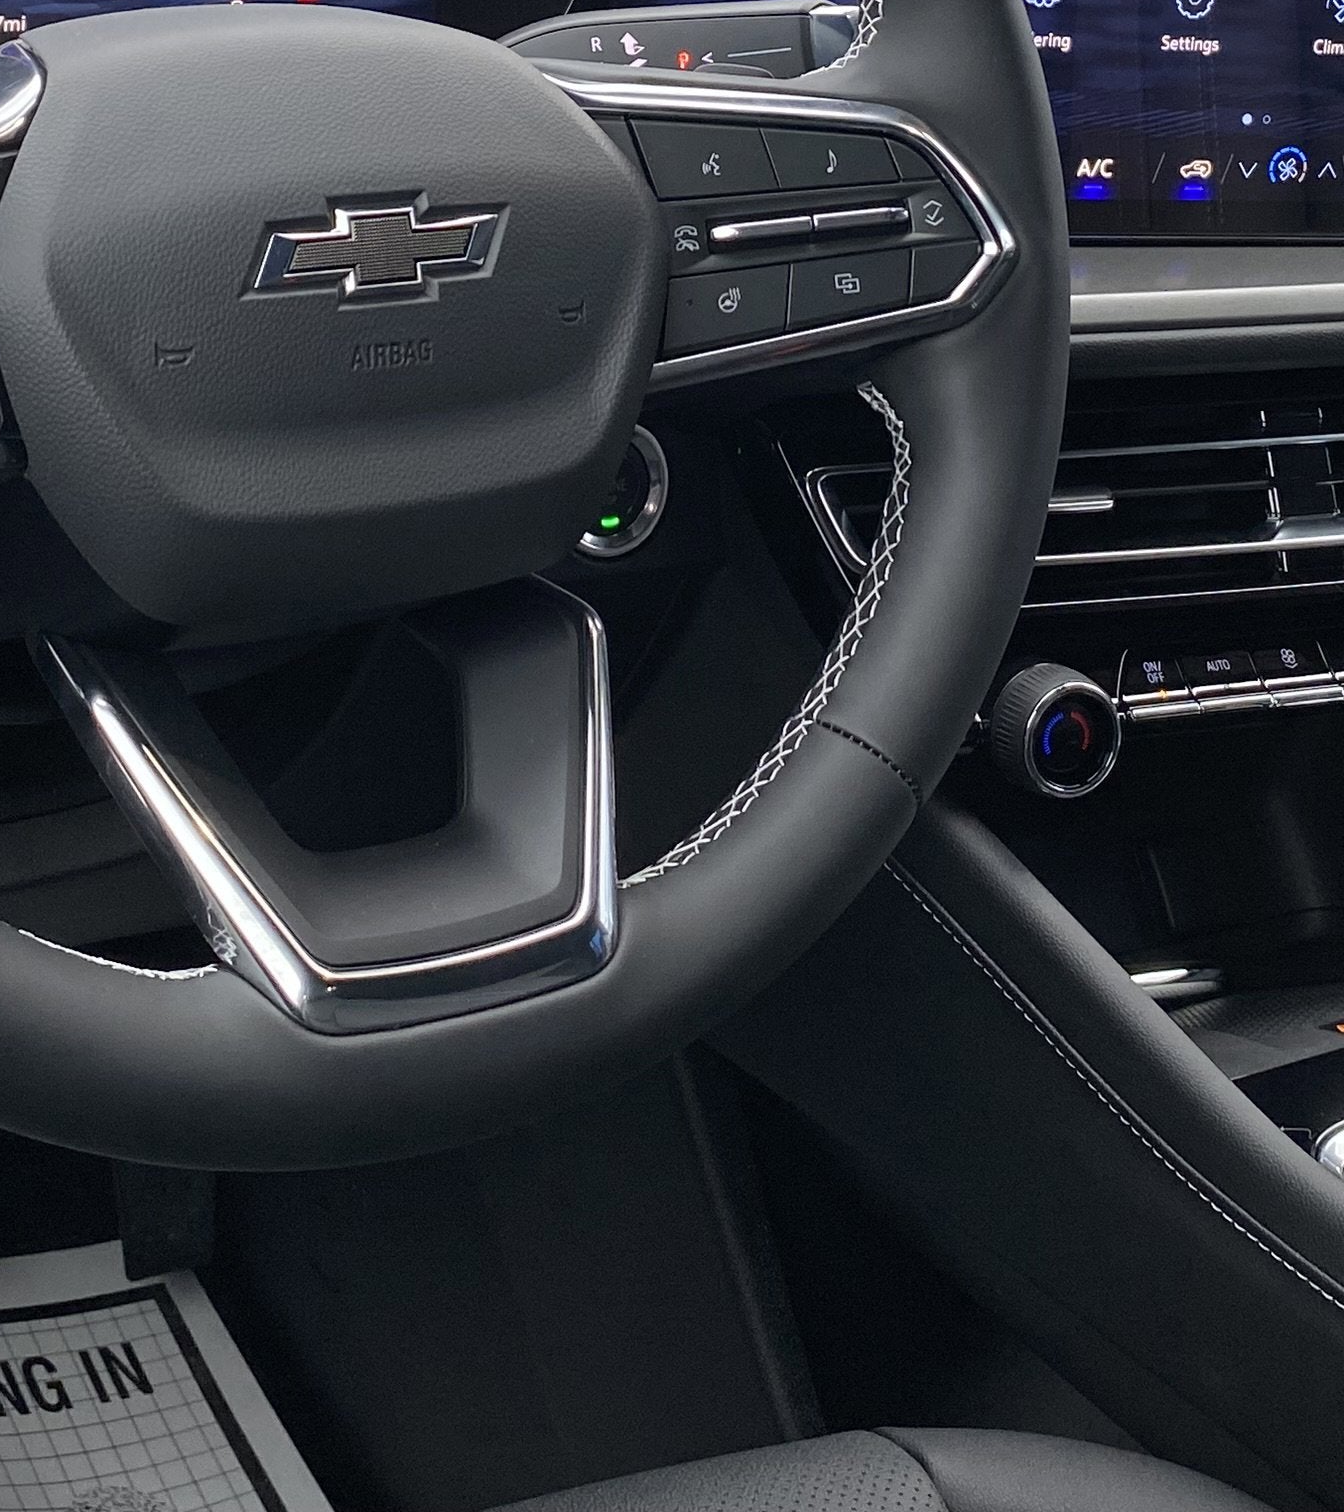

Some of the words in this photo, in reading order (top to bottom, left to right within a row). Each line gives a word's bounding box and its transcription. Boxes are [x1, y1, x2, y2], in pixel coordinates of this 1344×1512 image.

[590, 36, 602, 53] R
[1160, 34, 1220, 57] Settings
[1076, 158, 1114, 179] A/C
[352, 338, 434, 372] AIRBAG
[1206, 659, 1231, 672] AUTO
[1146, 671, 1165, 684] OFF
[83, 1342, 154, 1404] IN
